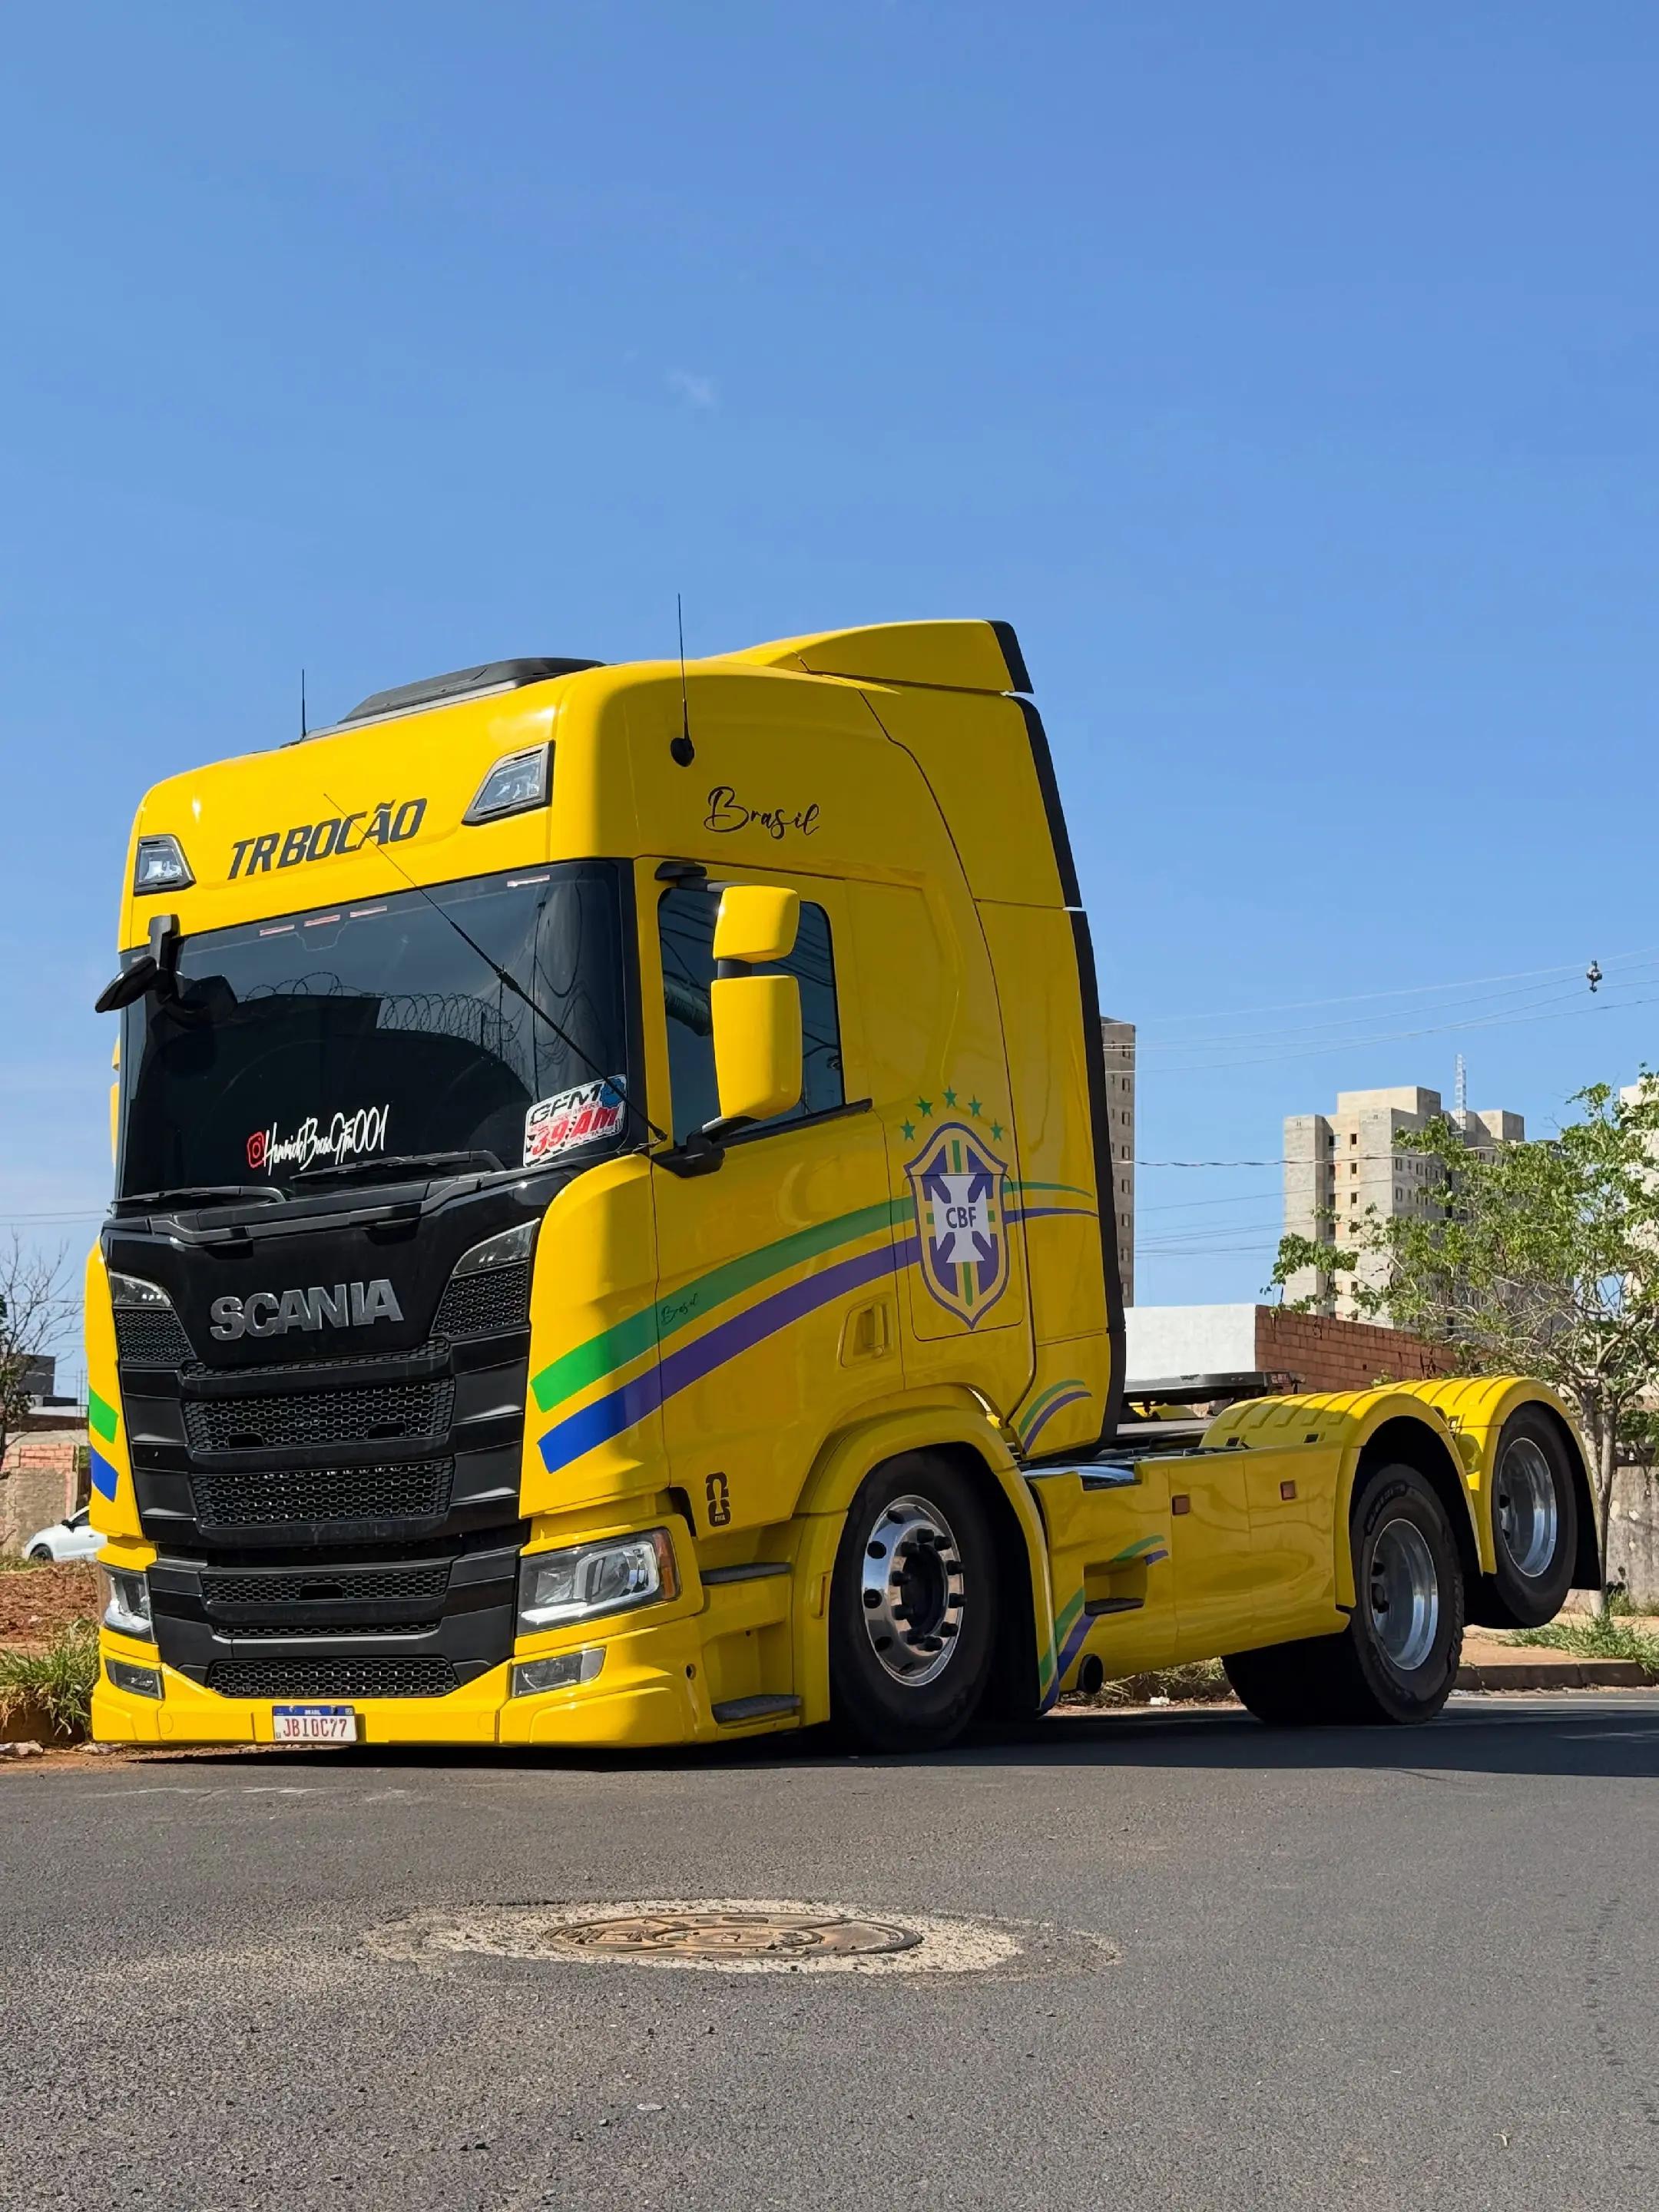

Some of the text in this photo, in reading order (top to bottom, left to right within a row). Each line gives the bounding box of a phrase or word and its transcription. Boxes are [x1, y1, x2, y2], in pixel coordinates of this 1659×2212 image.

[704, 786, 820, 839] Brasil
[945, 1206, 977, 1229] CBF
[210, 1279, 405, 1341] SCANIA
